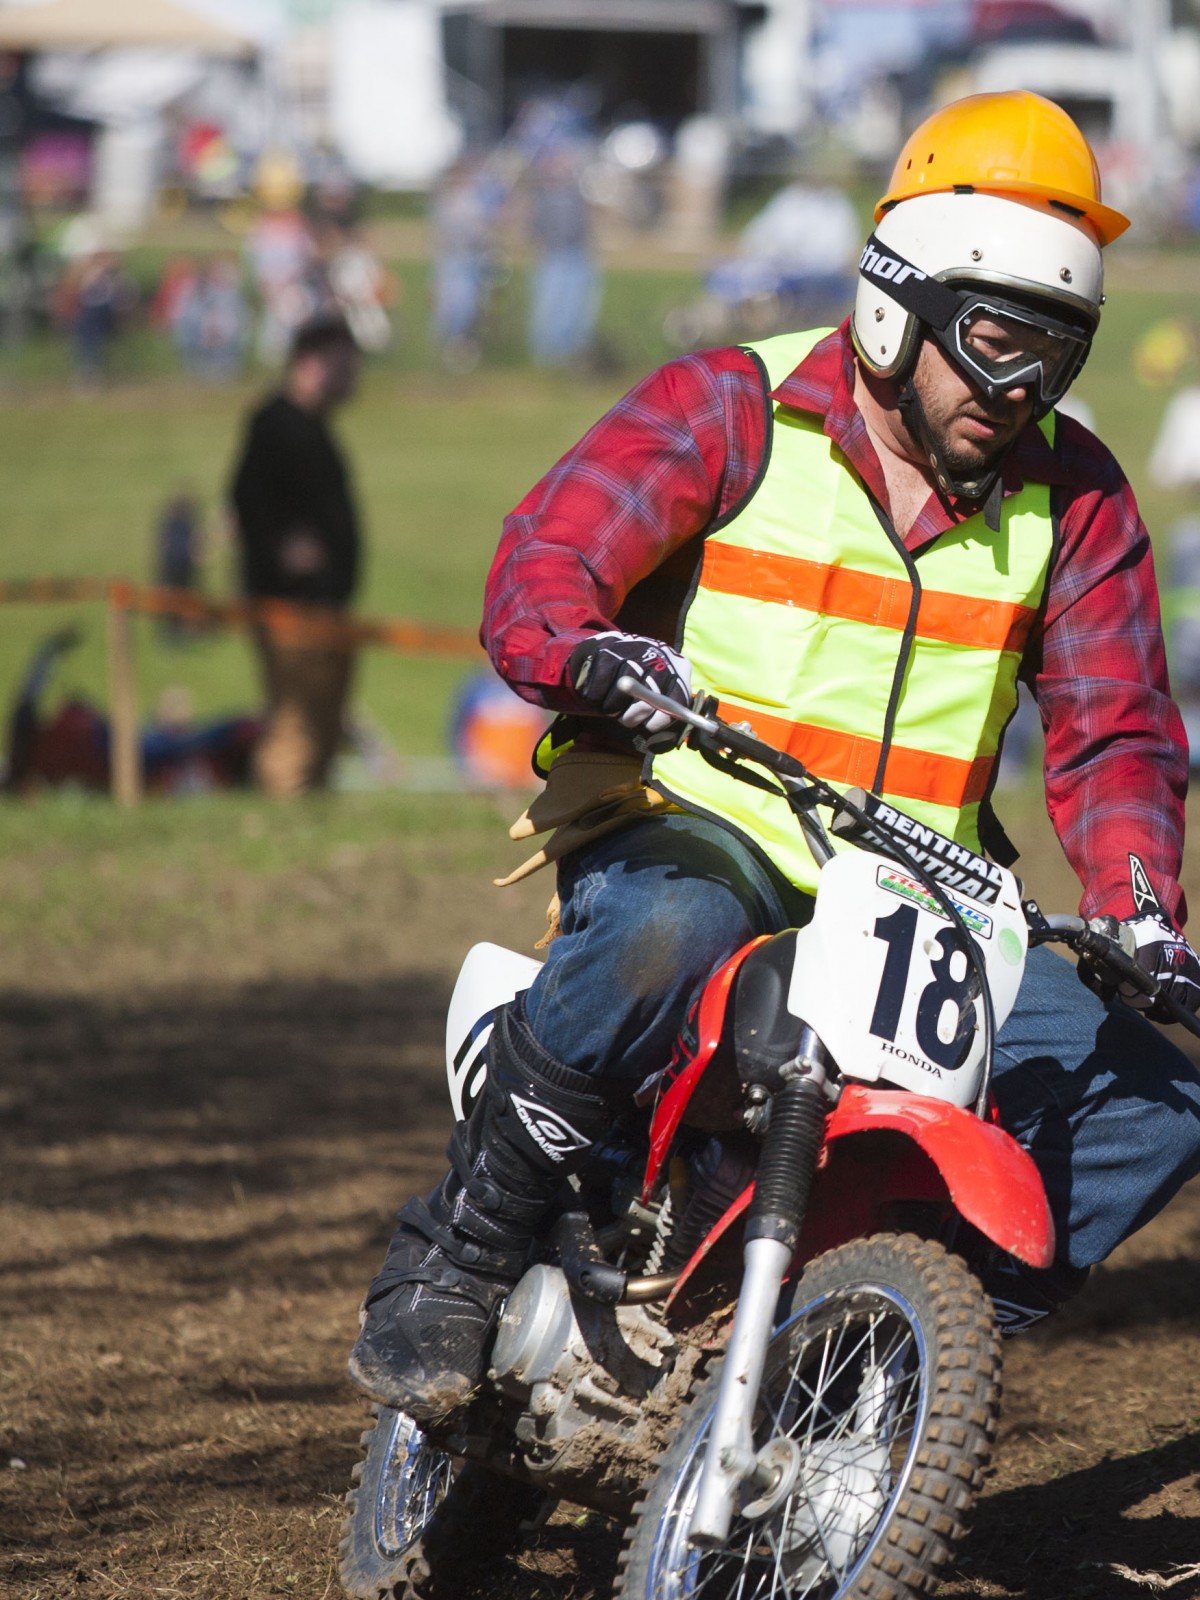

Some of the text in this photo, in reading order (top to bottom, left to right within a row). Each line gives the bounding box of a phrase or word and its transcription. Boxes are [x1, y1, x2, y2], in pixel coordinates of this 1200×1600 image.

[858, 243, 927, 285] thor
[874, 803, 1003, 886] RENTHAL
[1164, 948, 1186, 967] 1970
[868, 903, 987, 1071] 18
[879, 1042, 943, 1080] HONDA
